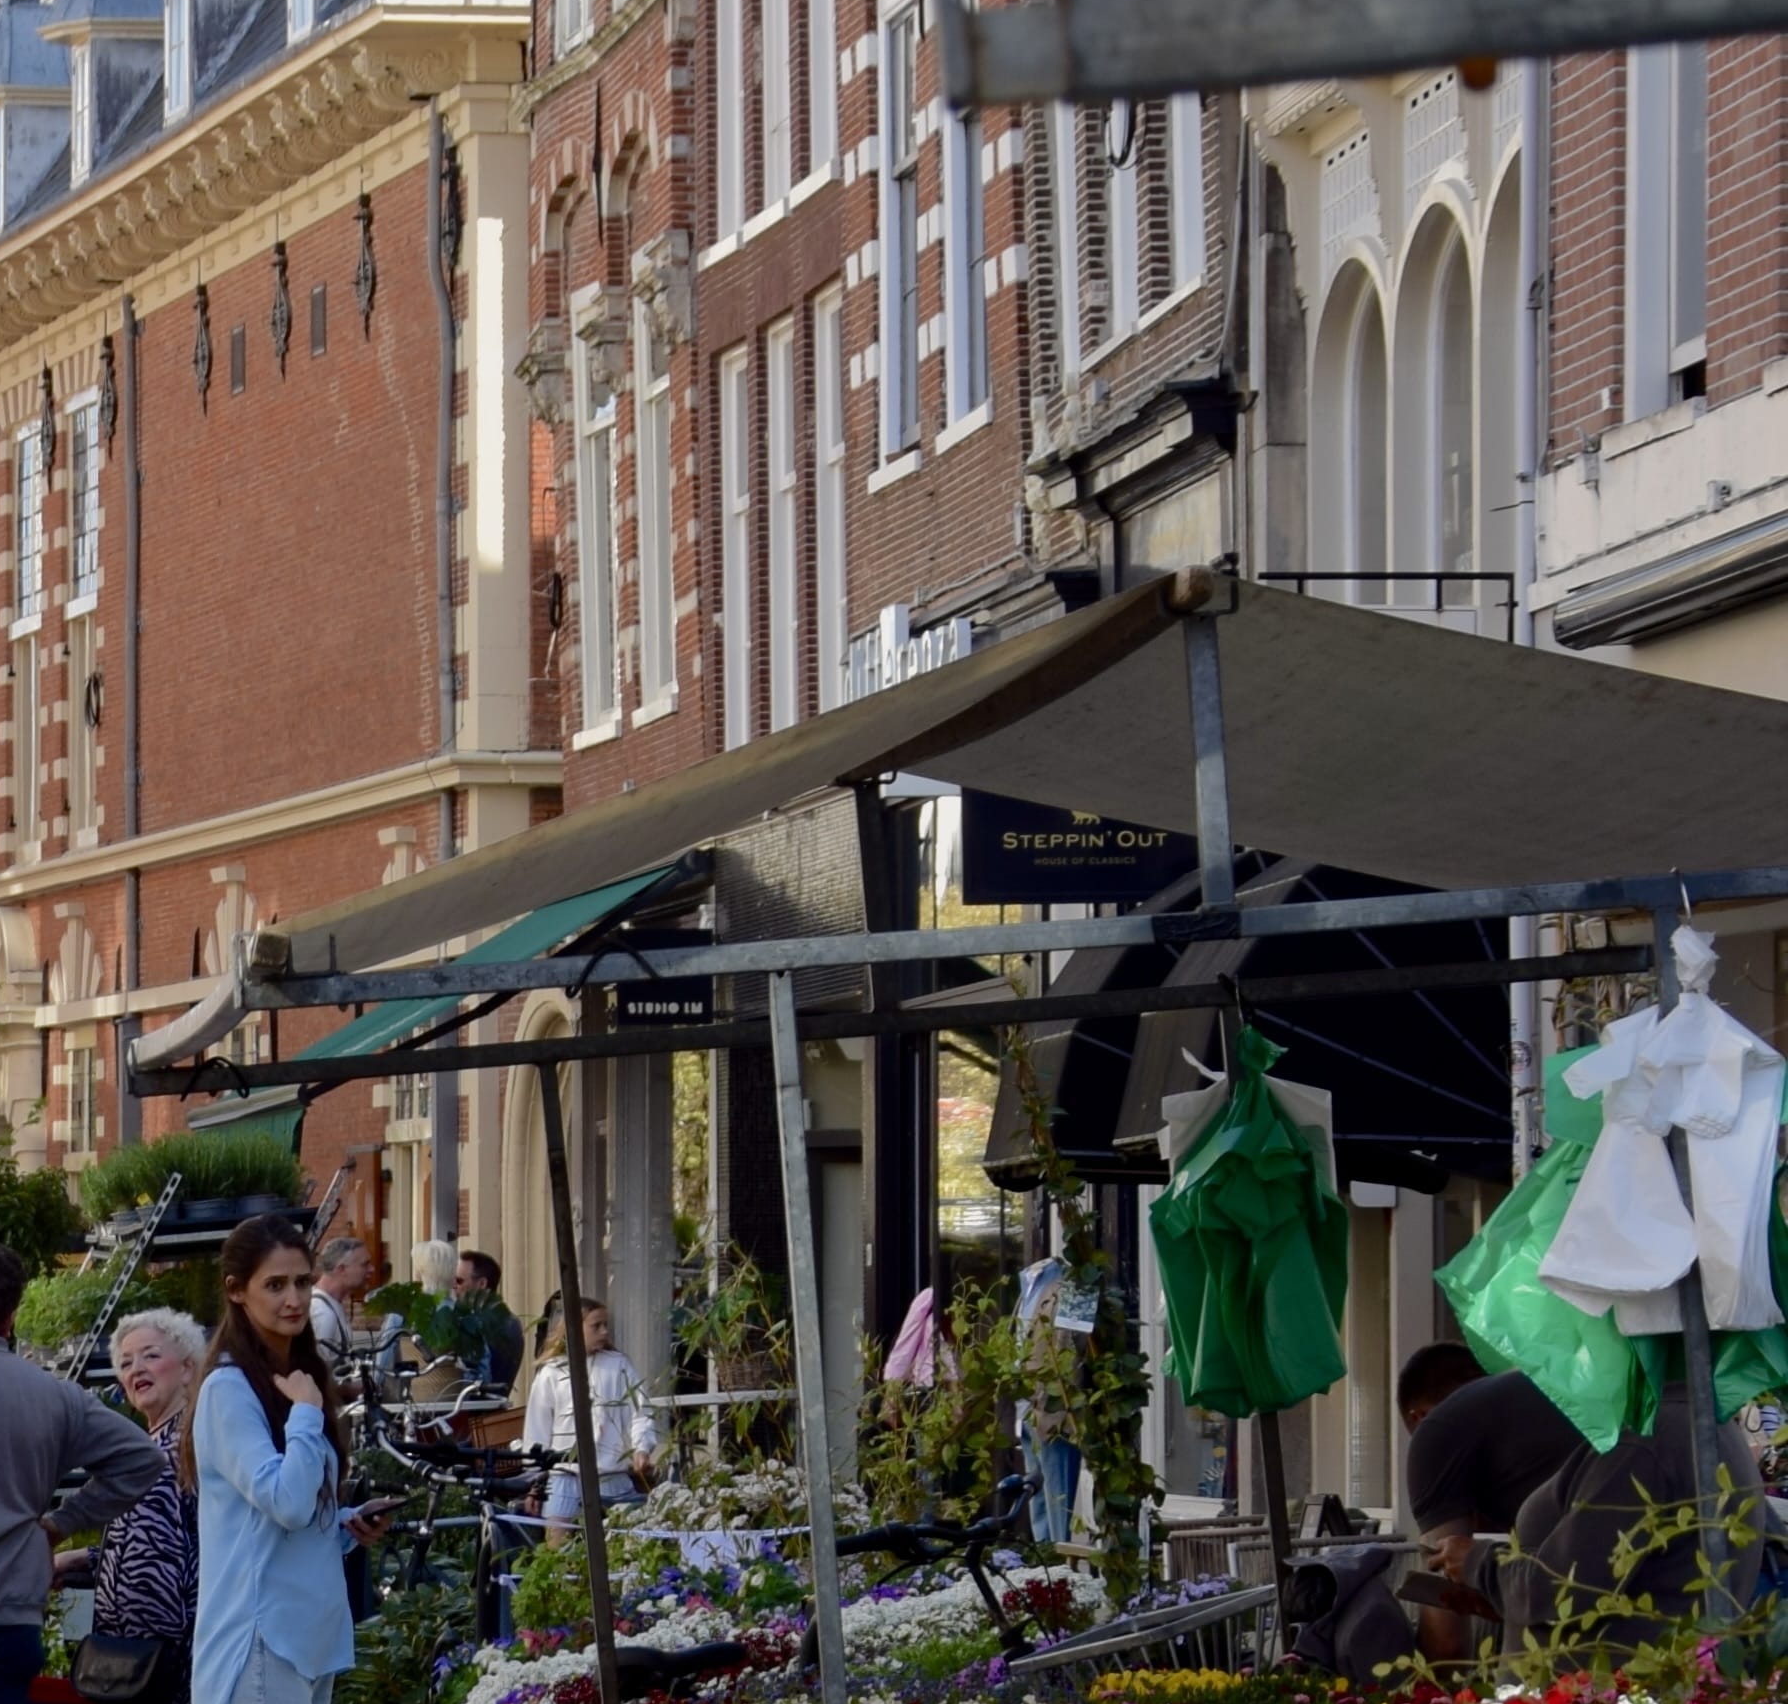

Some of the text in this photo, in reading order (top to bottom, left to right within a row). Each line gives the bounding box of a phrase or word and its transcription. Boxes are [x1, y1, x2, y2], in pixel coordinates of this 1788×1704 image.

[1003, 831, 1112, 849] STEPPIN'
[1034, 856, 1137, 866] HOUSE OF CLASSICS
[627, 1002, 680, 1014] STUDIO
